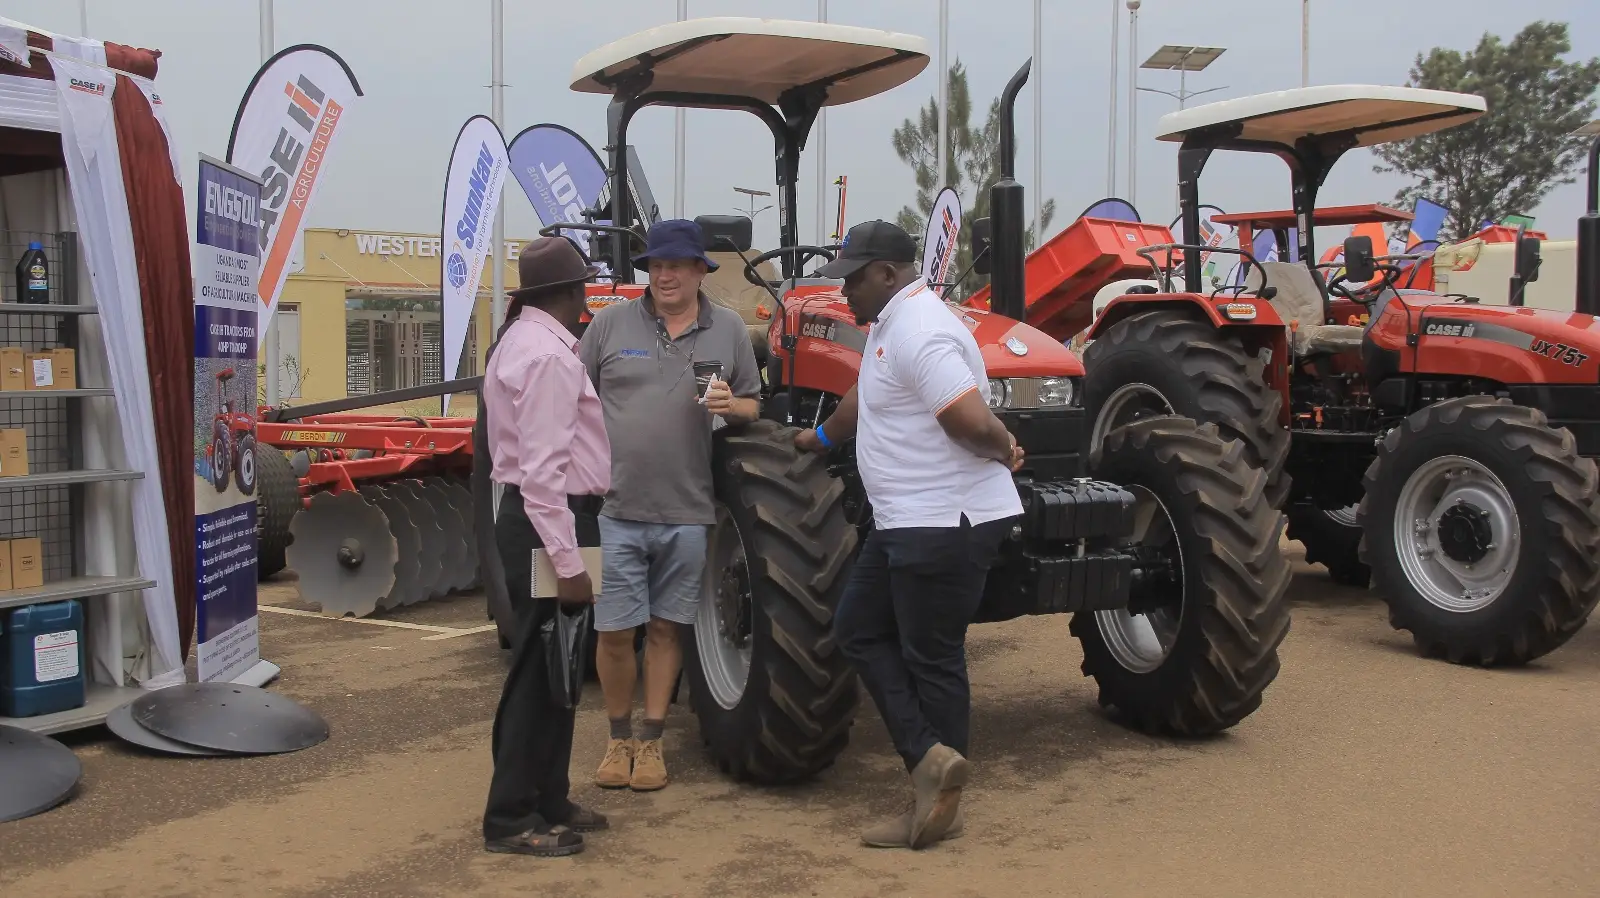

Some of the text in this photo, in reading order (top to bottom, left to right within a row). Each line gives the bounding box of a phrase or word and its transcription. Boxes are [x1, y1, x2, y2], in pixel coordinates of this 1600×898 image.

[70, 78, 96, 90] CASE
[292, 106, 339, 210] AGRICULTURE
[486, 156, 502, 203] Technology
[204, 179, 258, 228] ENGSOL
[259, 126, 305, 253] ASE
[456, 139, 494, 250] SunNav
[354, 233, 442, 258] WESTER
[802, 322, 826, 339] CASE
[1426, 323, 1462, 336] CASE
